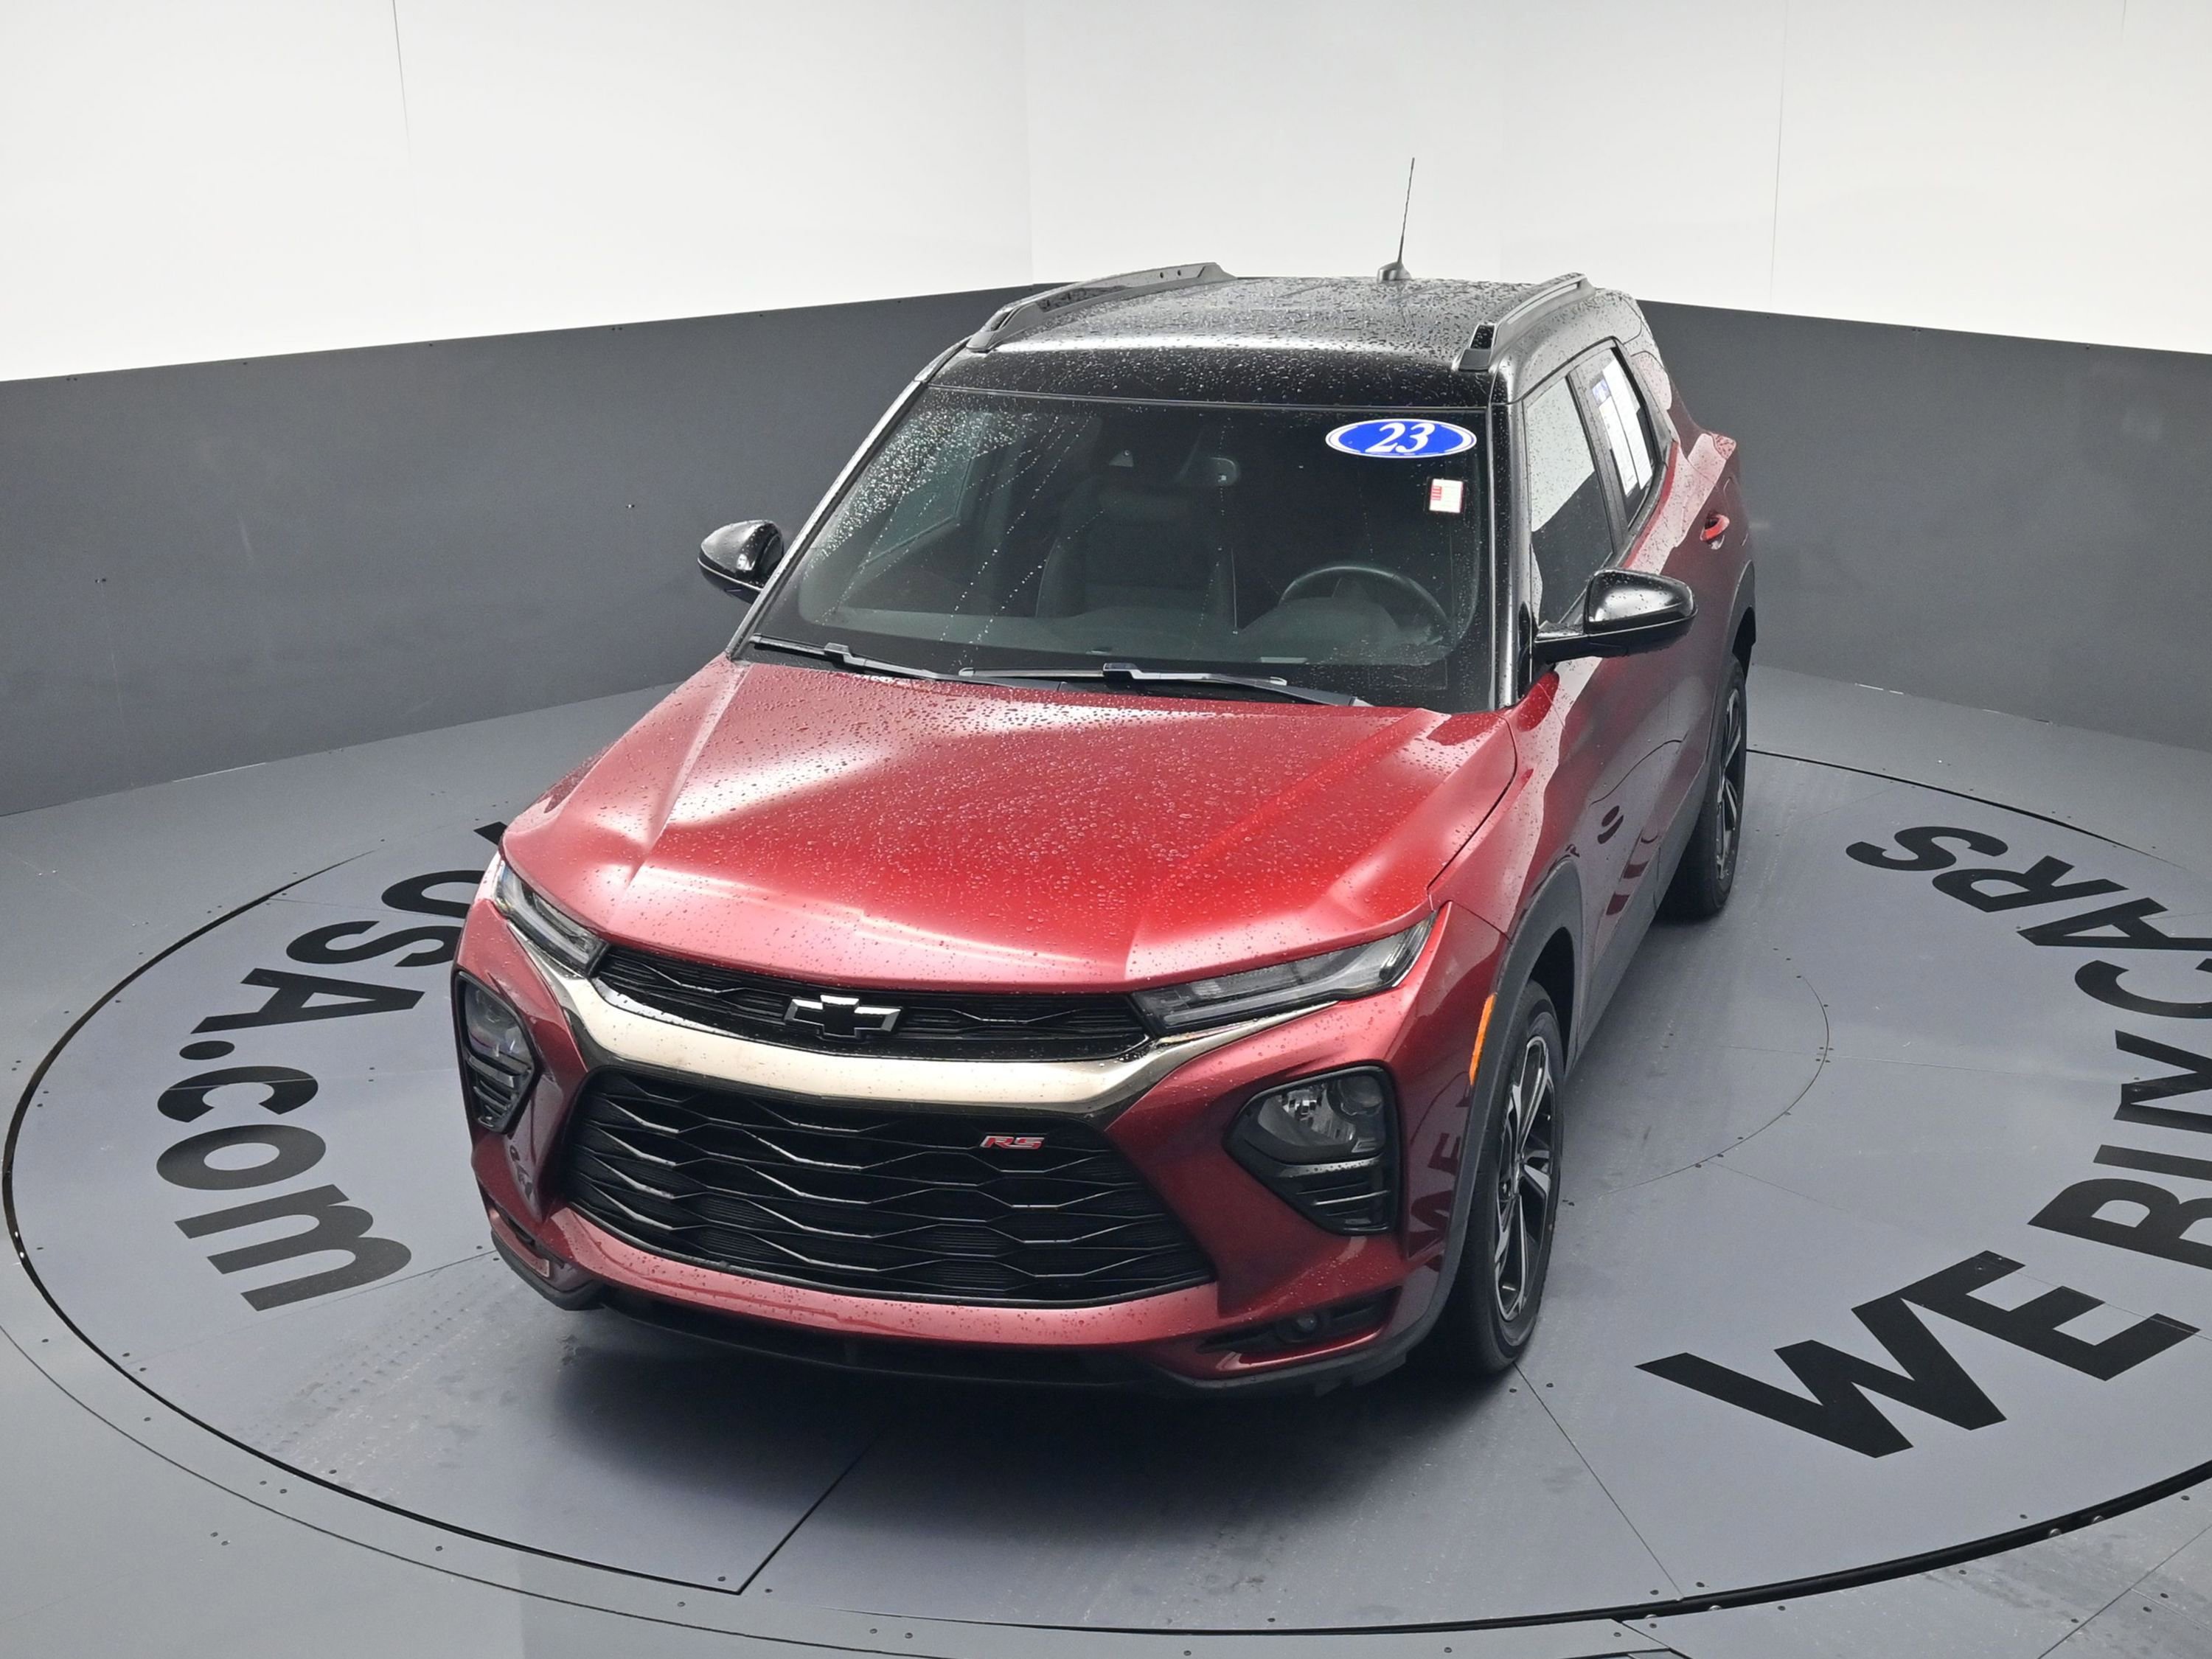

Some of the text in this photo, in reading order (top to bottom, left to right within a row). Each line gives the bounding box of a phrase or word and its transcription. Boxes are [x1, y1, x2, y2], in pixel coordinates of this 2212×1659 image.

[1365, 422, 1436, 453] 23
[1846, 826, 2212, 1019] CARS
[156, 821, 508, 1311] USA.com
[980, 1135, 1045, 1150] RS
[1635, 1250, 2200, 1458] WE
